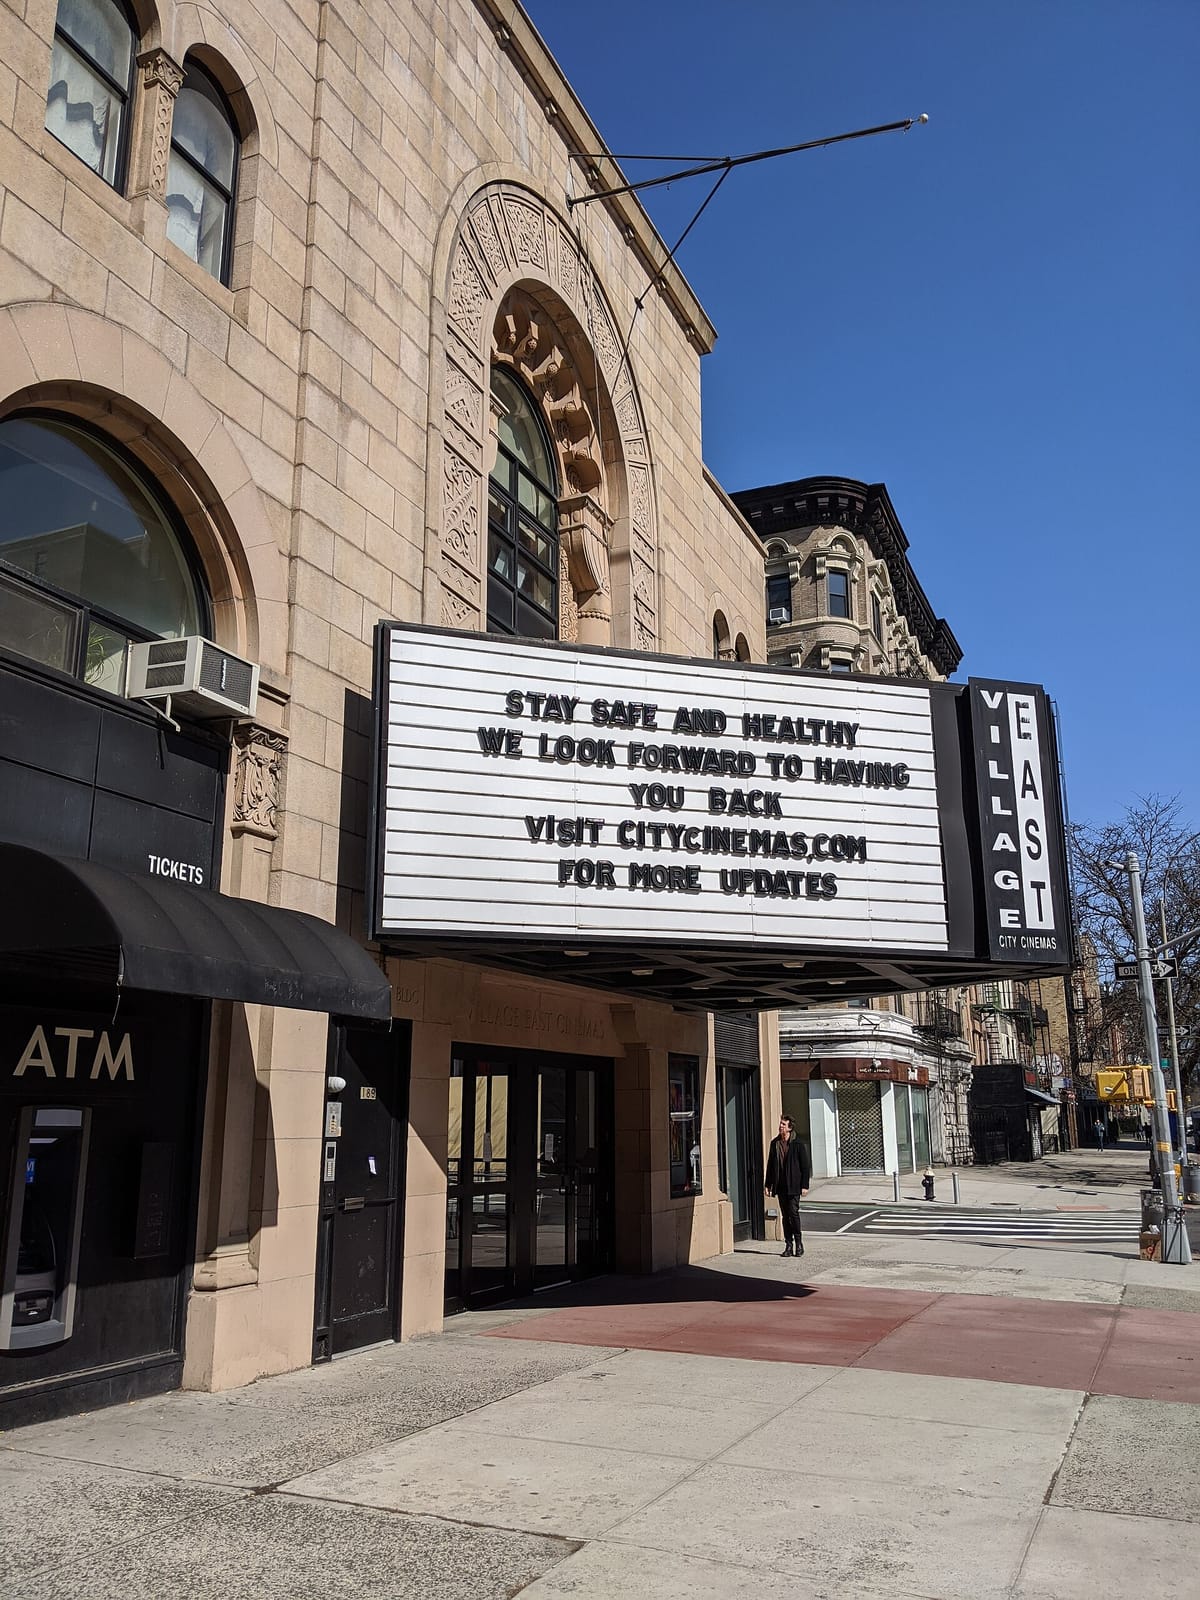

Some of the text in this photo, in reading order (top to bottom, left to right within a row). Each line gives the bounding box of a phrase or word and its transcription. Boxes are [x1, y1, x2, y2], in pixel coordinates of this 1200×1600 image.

[505, 690, 859, 747] STAY SAFE AND HEALTHY
[477, 727, 910, 788] WE LOOK FORWARD TO HAVING
[629, 783, 783, 818] YOU BACK
[980, 690, 1021, 928] VILLAGE
[1015, 701, 1046, 922] EAST
[525, 815, 605, 845] VISIT
[148, 854, 204, 885] TICKETS
[558, 859, 837, 900] FOR MORE UPDATES
[999, 935, 1057, 950] CITY CINEMAS
[12, 1024, 135, 1082] ATM
[361, 1087, 376, 1099] 189
